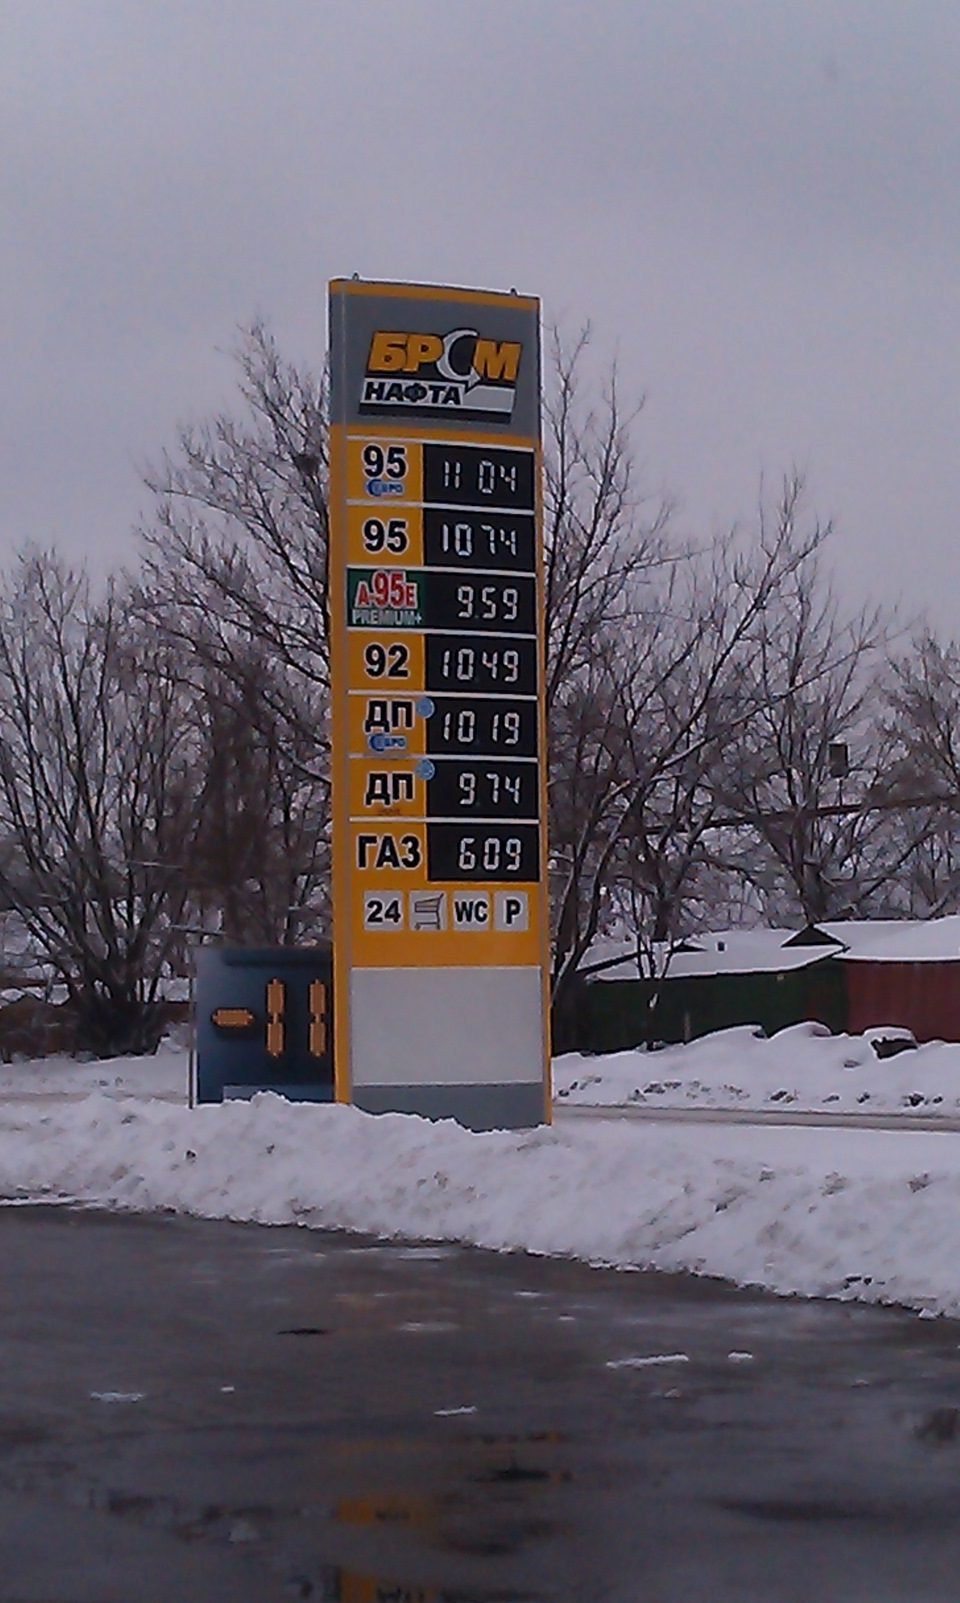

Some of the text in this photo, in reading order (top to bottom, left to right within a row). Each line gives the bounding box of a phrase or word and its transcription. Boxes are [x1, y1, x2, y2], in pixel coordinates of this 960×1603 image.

[368, 328, 522, 382] БРСМ
[364, 382, 461, 405] НАФТА
[363, 444, 408, 478] 95
[363, 518, 408, 553] 95
[365, 643, 409, 678] 92
[365, 699, 414, 733] ДП
[365, 772, 414, 806] ДП
[357, 834, 421, 869] ГАЗ
[459, 838, 521, 870] 609
[366, 899, 521, 925] 24 WC P
